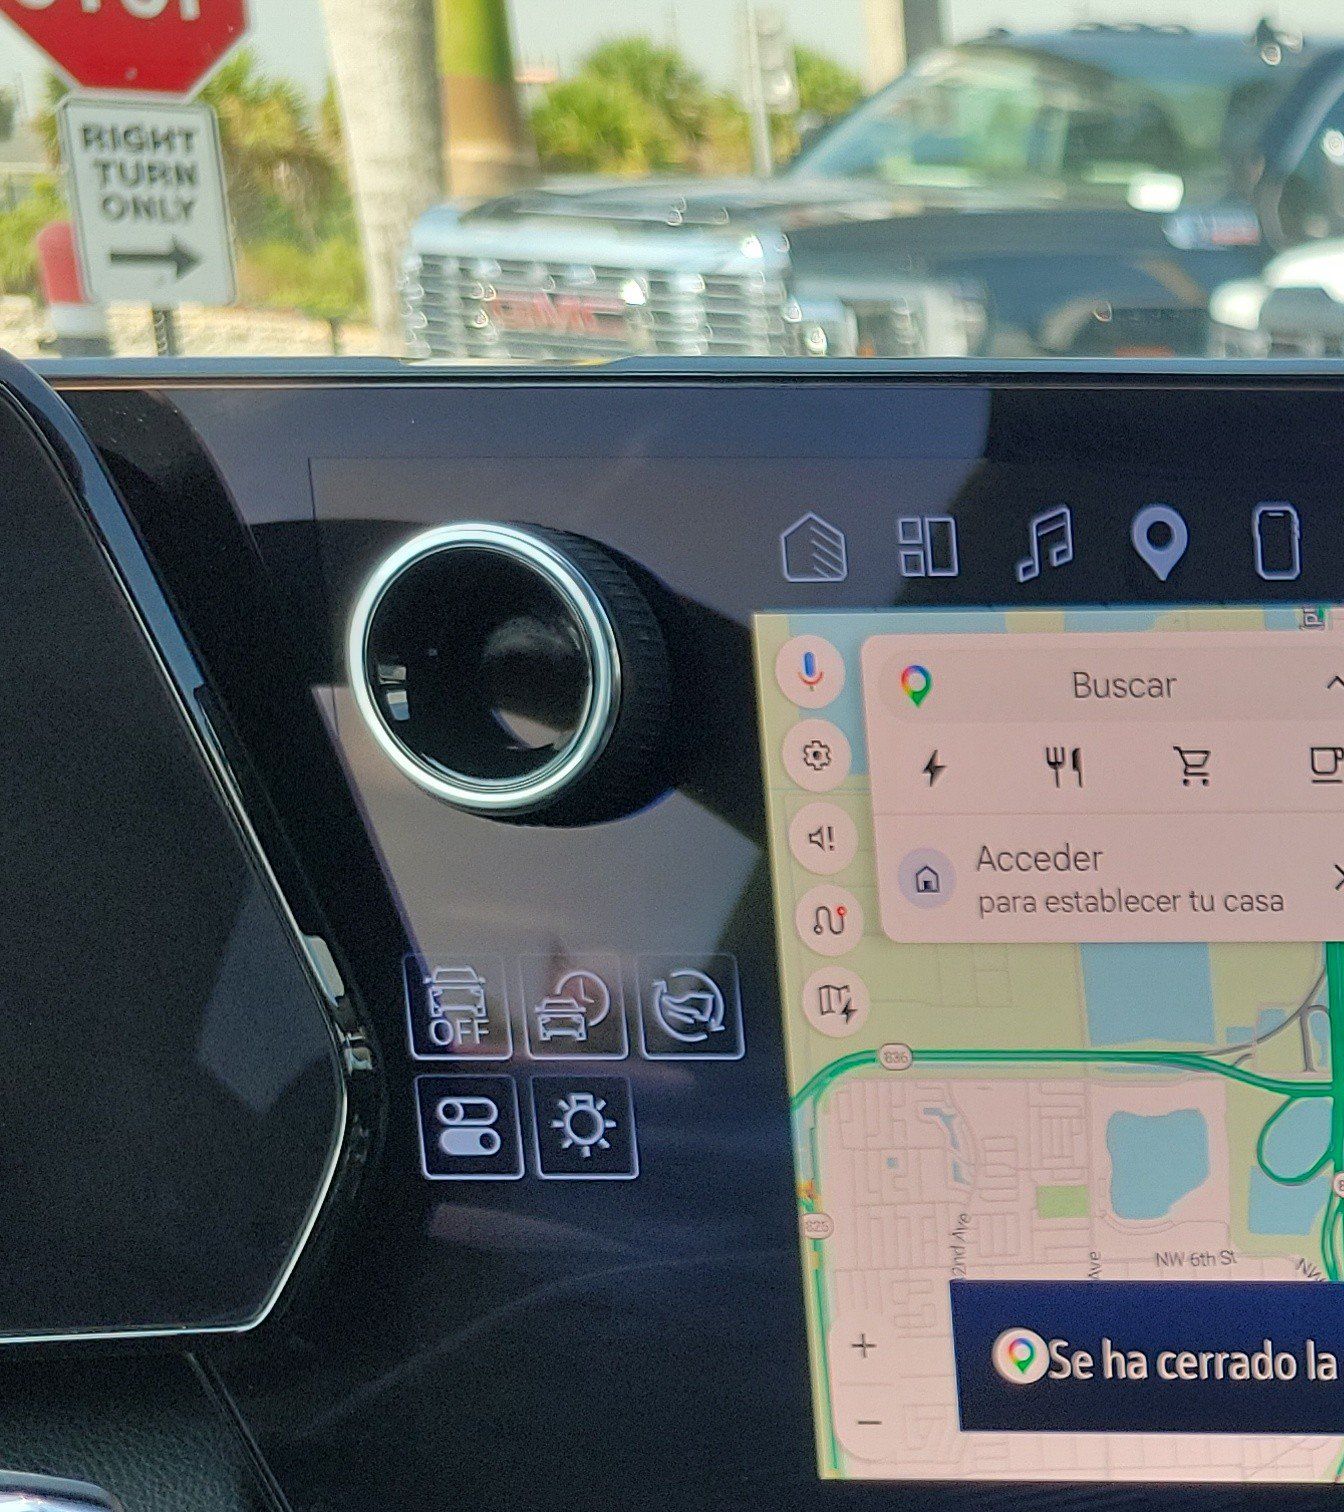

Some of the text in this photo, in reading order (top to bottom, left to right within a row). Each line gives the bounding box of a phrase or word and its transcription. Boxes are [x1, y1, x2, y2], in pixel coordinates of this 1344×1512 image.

[81, 123, 195, 154] RIGHT
[94, 159, 196, 187] TURN
[102, 191, 195, 222] ONLY
[1072, 671, 1177, 700] Buscar
[977, 842, 1104, 873] Acceder
[979, 889, 1284, 918] para establecer tu casa
[429, 1018, 490, 1046] OFF
[949, 1246, 966, 1280] 2nd
[1156, 1253, 1185, 1268] NW
[1220, 1250, 1237, 1266] St
[1049, 1339, 1093, 1381] Se
[1102, 1338, 1149, 1381] ha
[1157, 1338, 1296, 1381] cerrado
[1307, 1338, 1338, 1381] la
